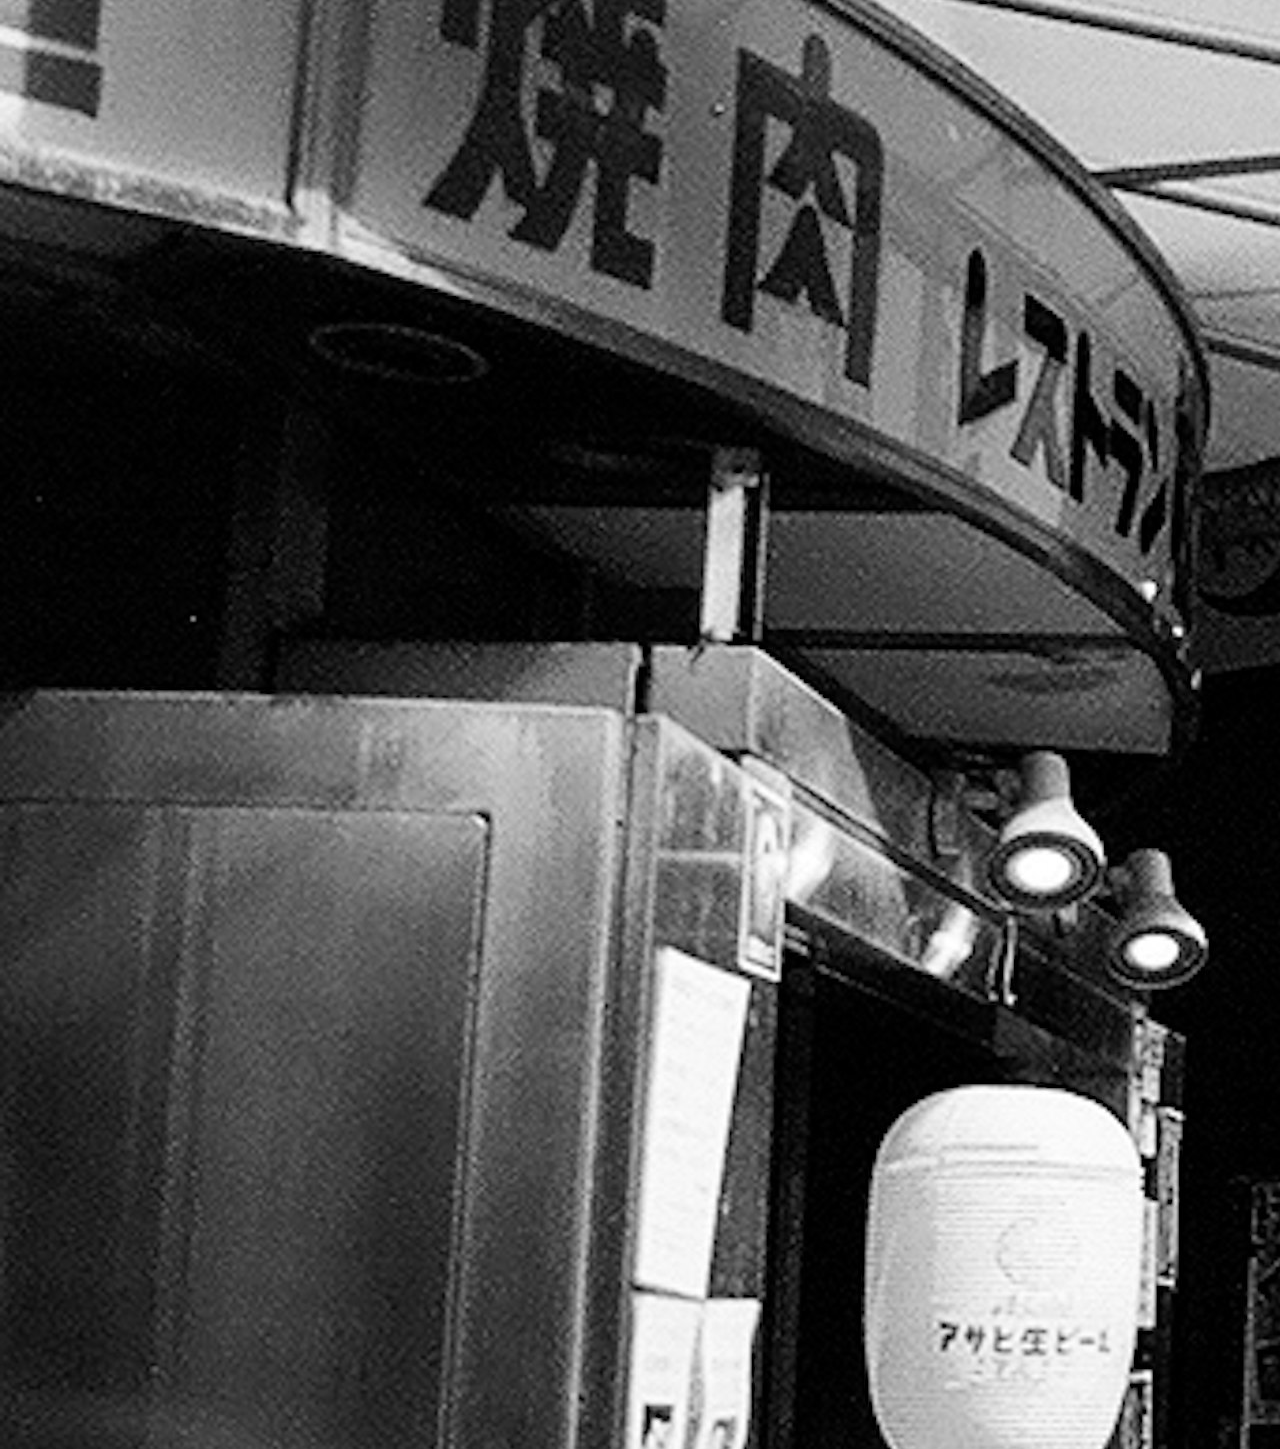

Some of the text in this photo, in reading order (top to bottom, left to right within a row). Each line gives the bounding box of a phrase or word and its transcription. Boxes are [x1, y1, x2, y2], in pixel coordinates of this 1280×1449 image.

[957, 246, 1168, 557] レストラン
